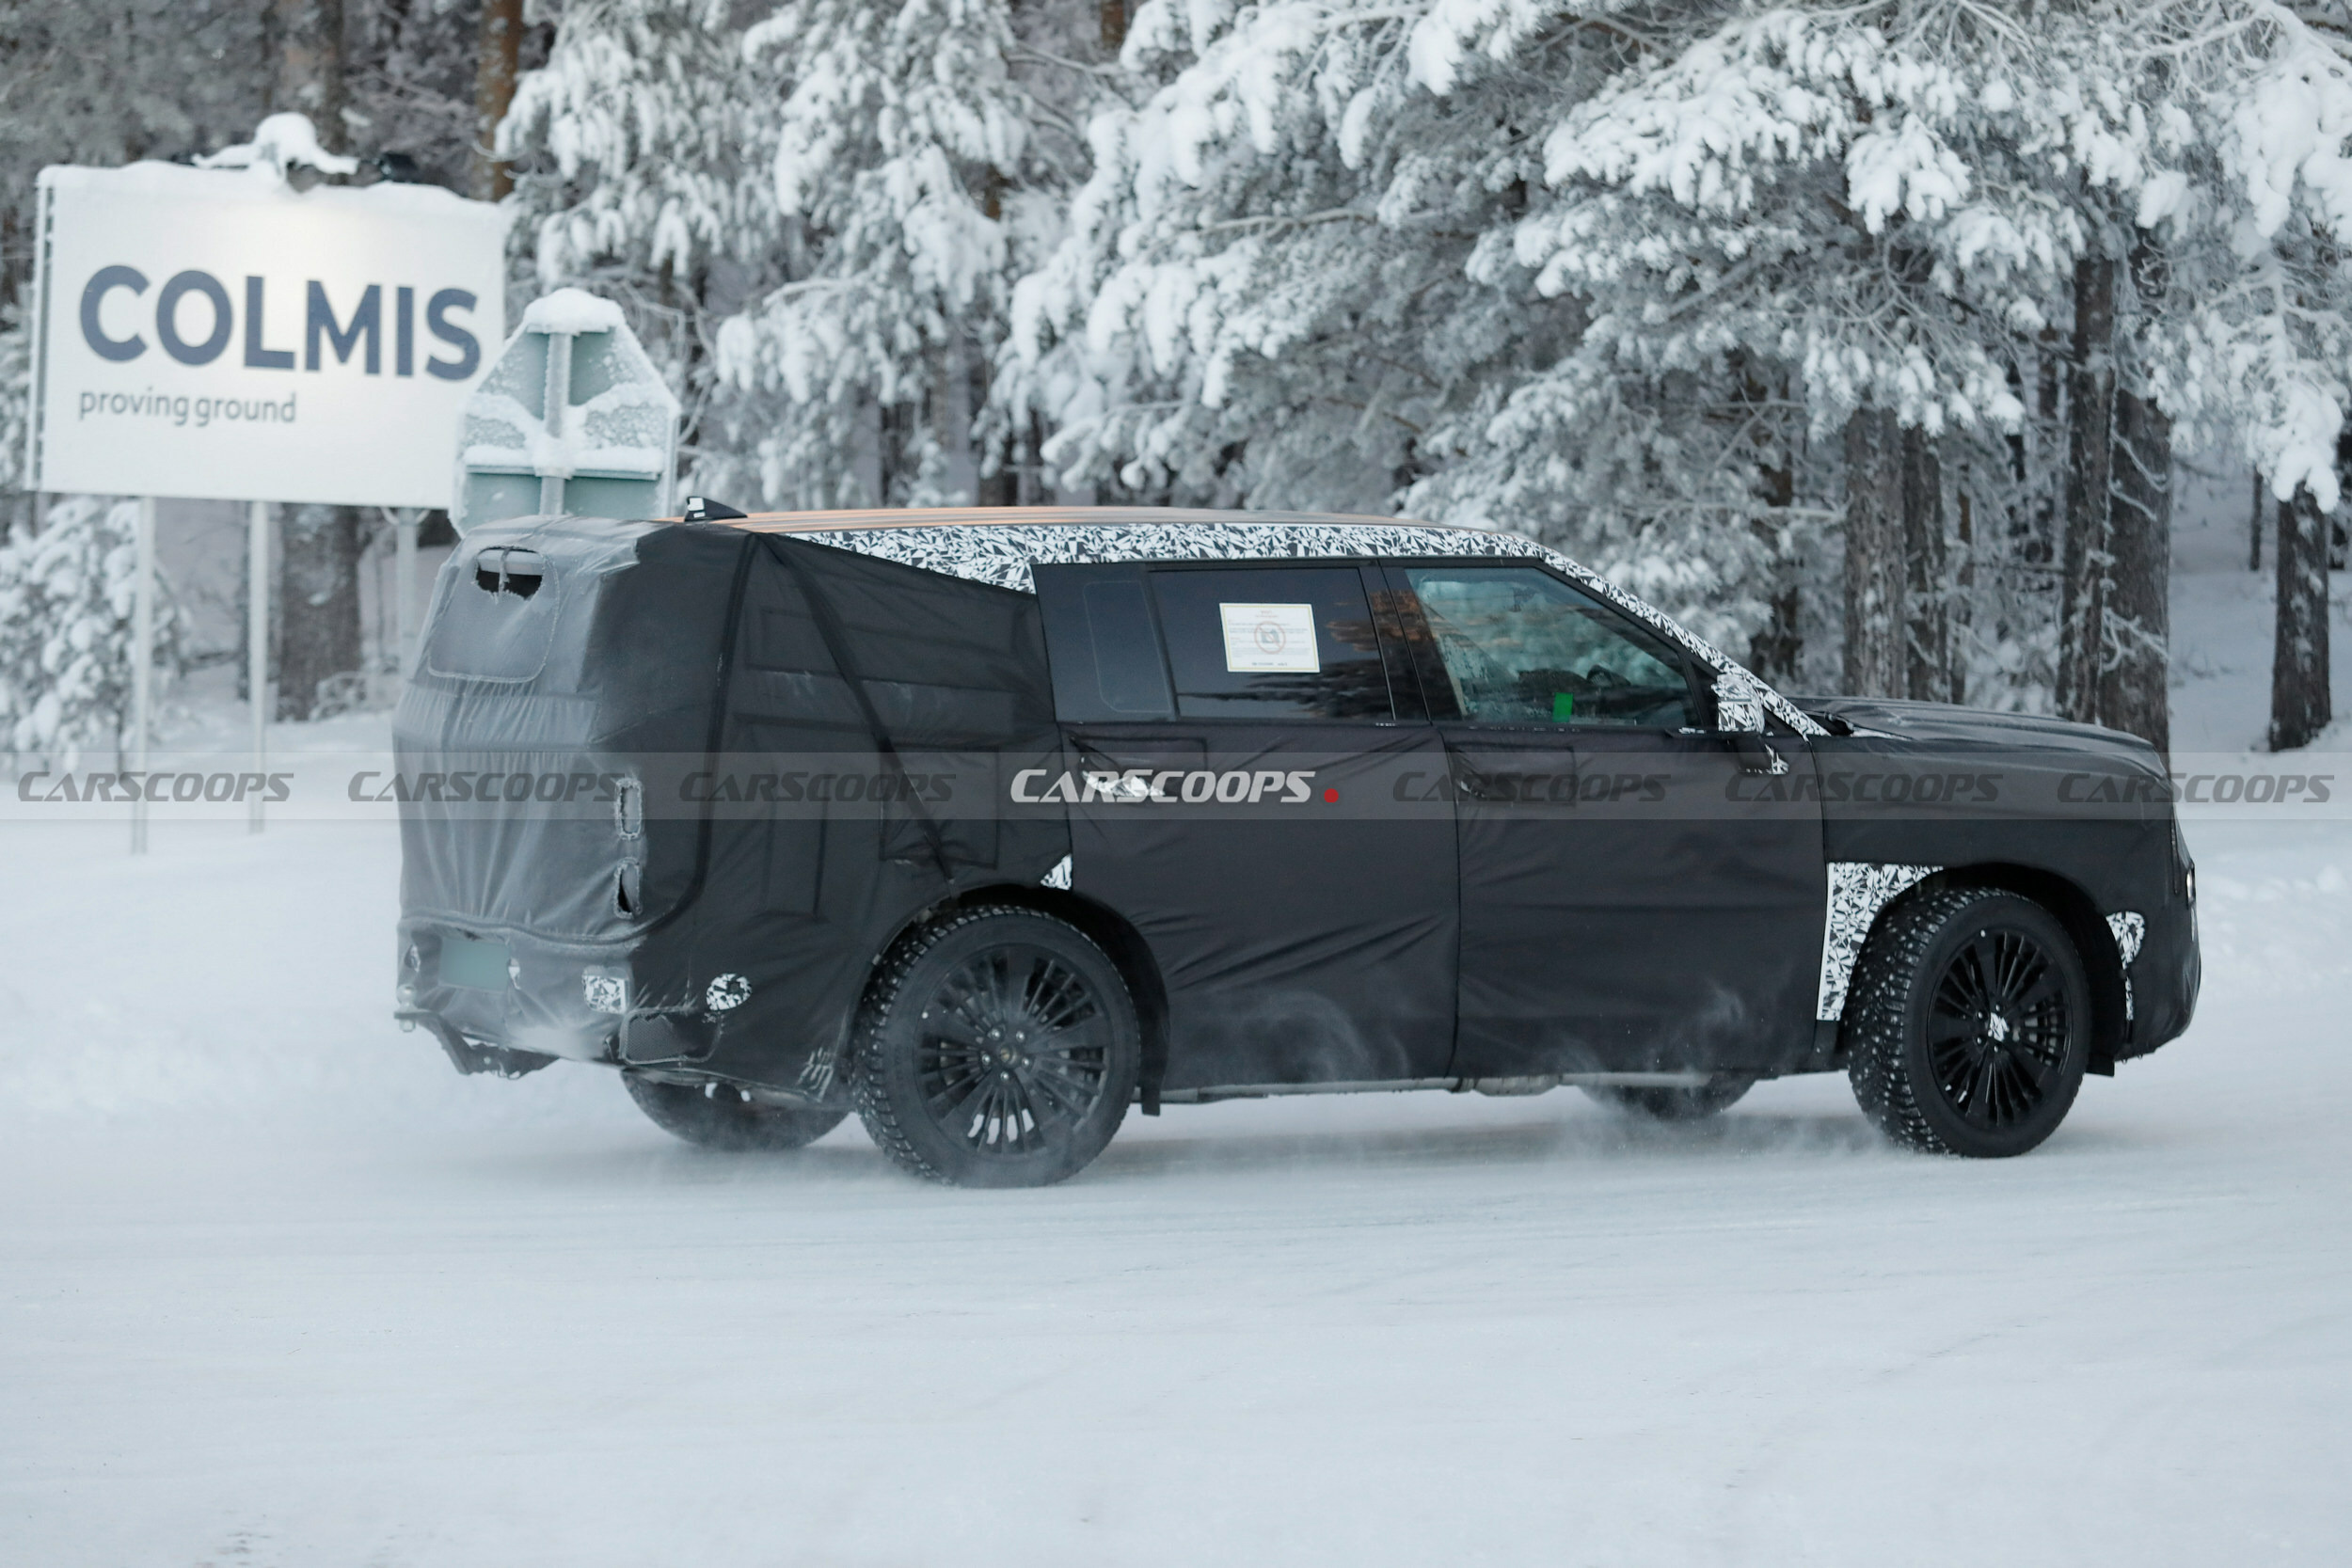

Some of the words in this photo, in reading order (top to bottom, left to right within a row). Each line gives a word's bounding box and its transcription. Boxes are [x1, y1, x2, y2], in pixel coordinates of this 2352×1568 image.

[80, 264, 482, 382] COLMIS
[79, 385, 188, 426] proving
[195, 390, 296, 427] ground
